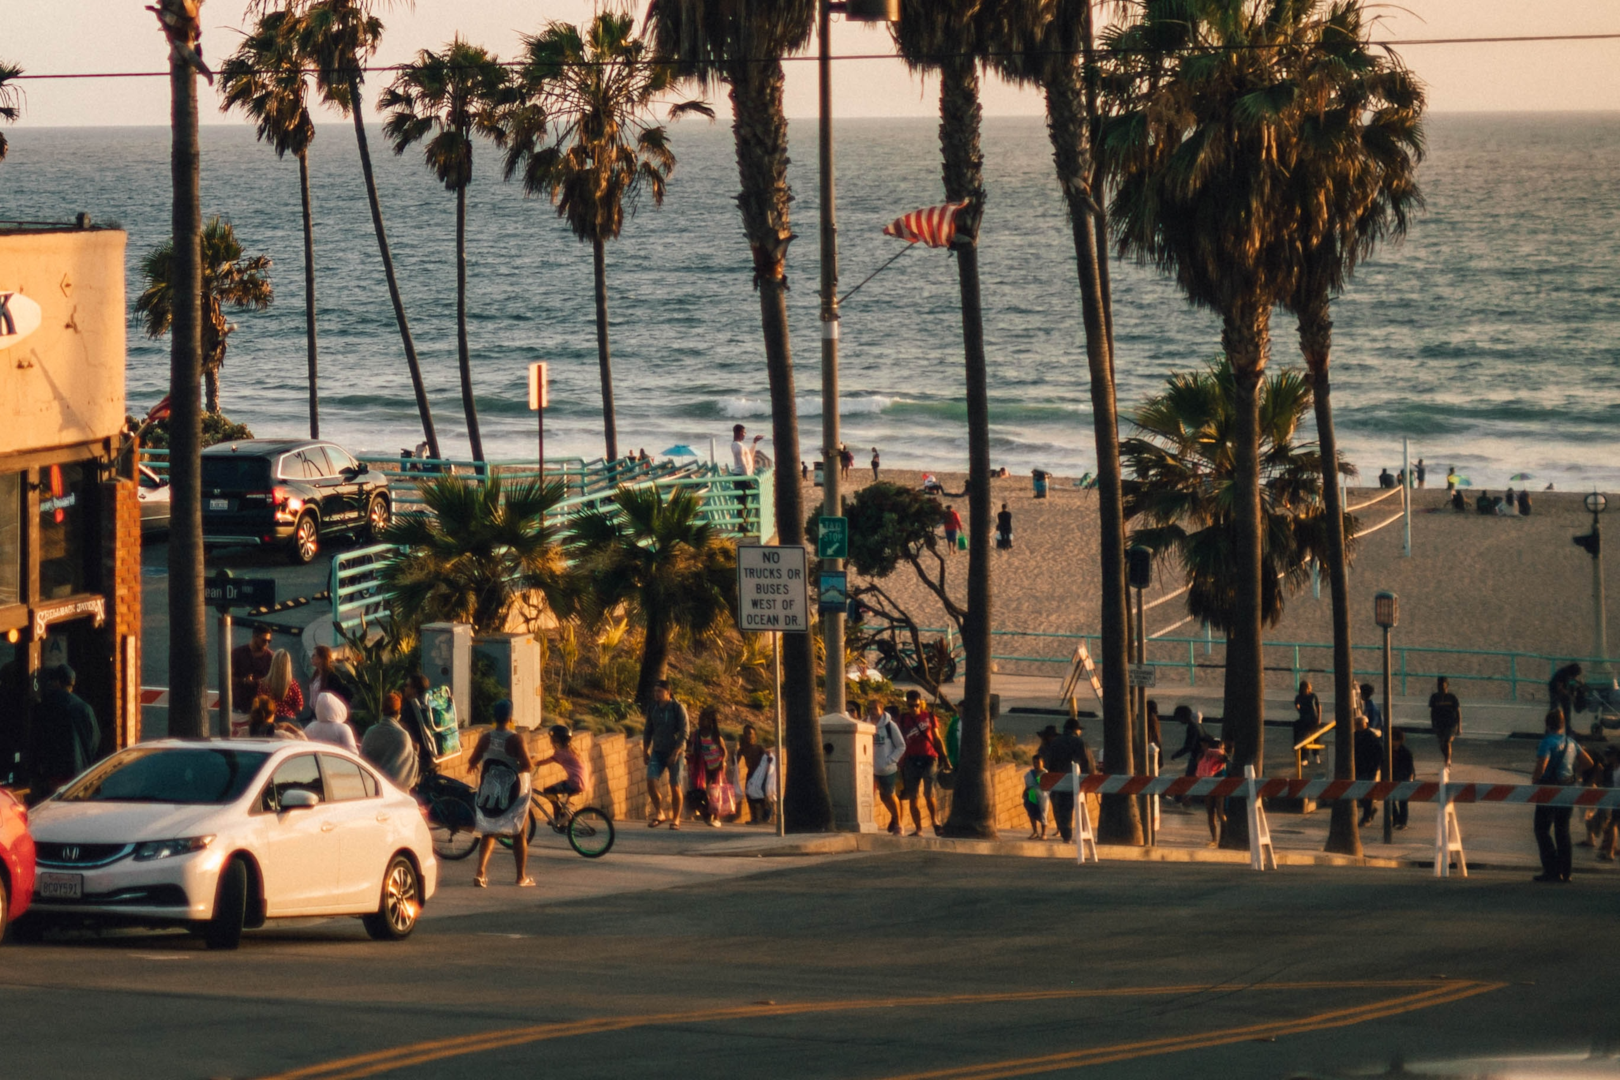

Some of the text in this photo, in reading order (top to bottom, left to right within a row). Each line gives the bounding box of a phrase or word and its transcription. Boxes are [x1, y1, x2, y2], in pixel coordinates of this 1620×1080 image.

[823, 532, 843, 542] STOP
[762, 551, 780, 564] NO
[743, 567, 801, 580] TRUCKS OR
[205, 587, 223, 599] ean
[226, 584, 238, 599] Dr
[755, 583, 789, 595] BUSES
[750, 598, 795, 611] WEST OF
[746, 614, 801, 626] OCEAN DR.
